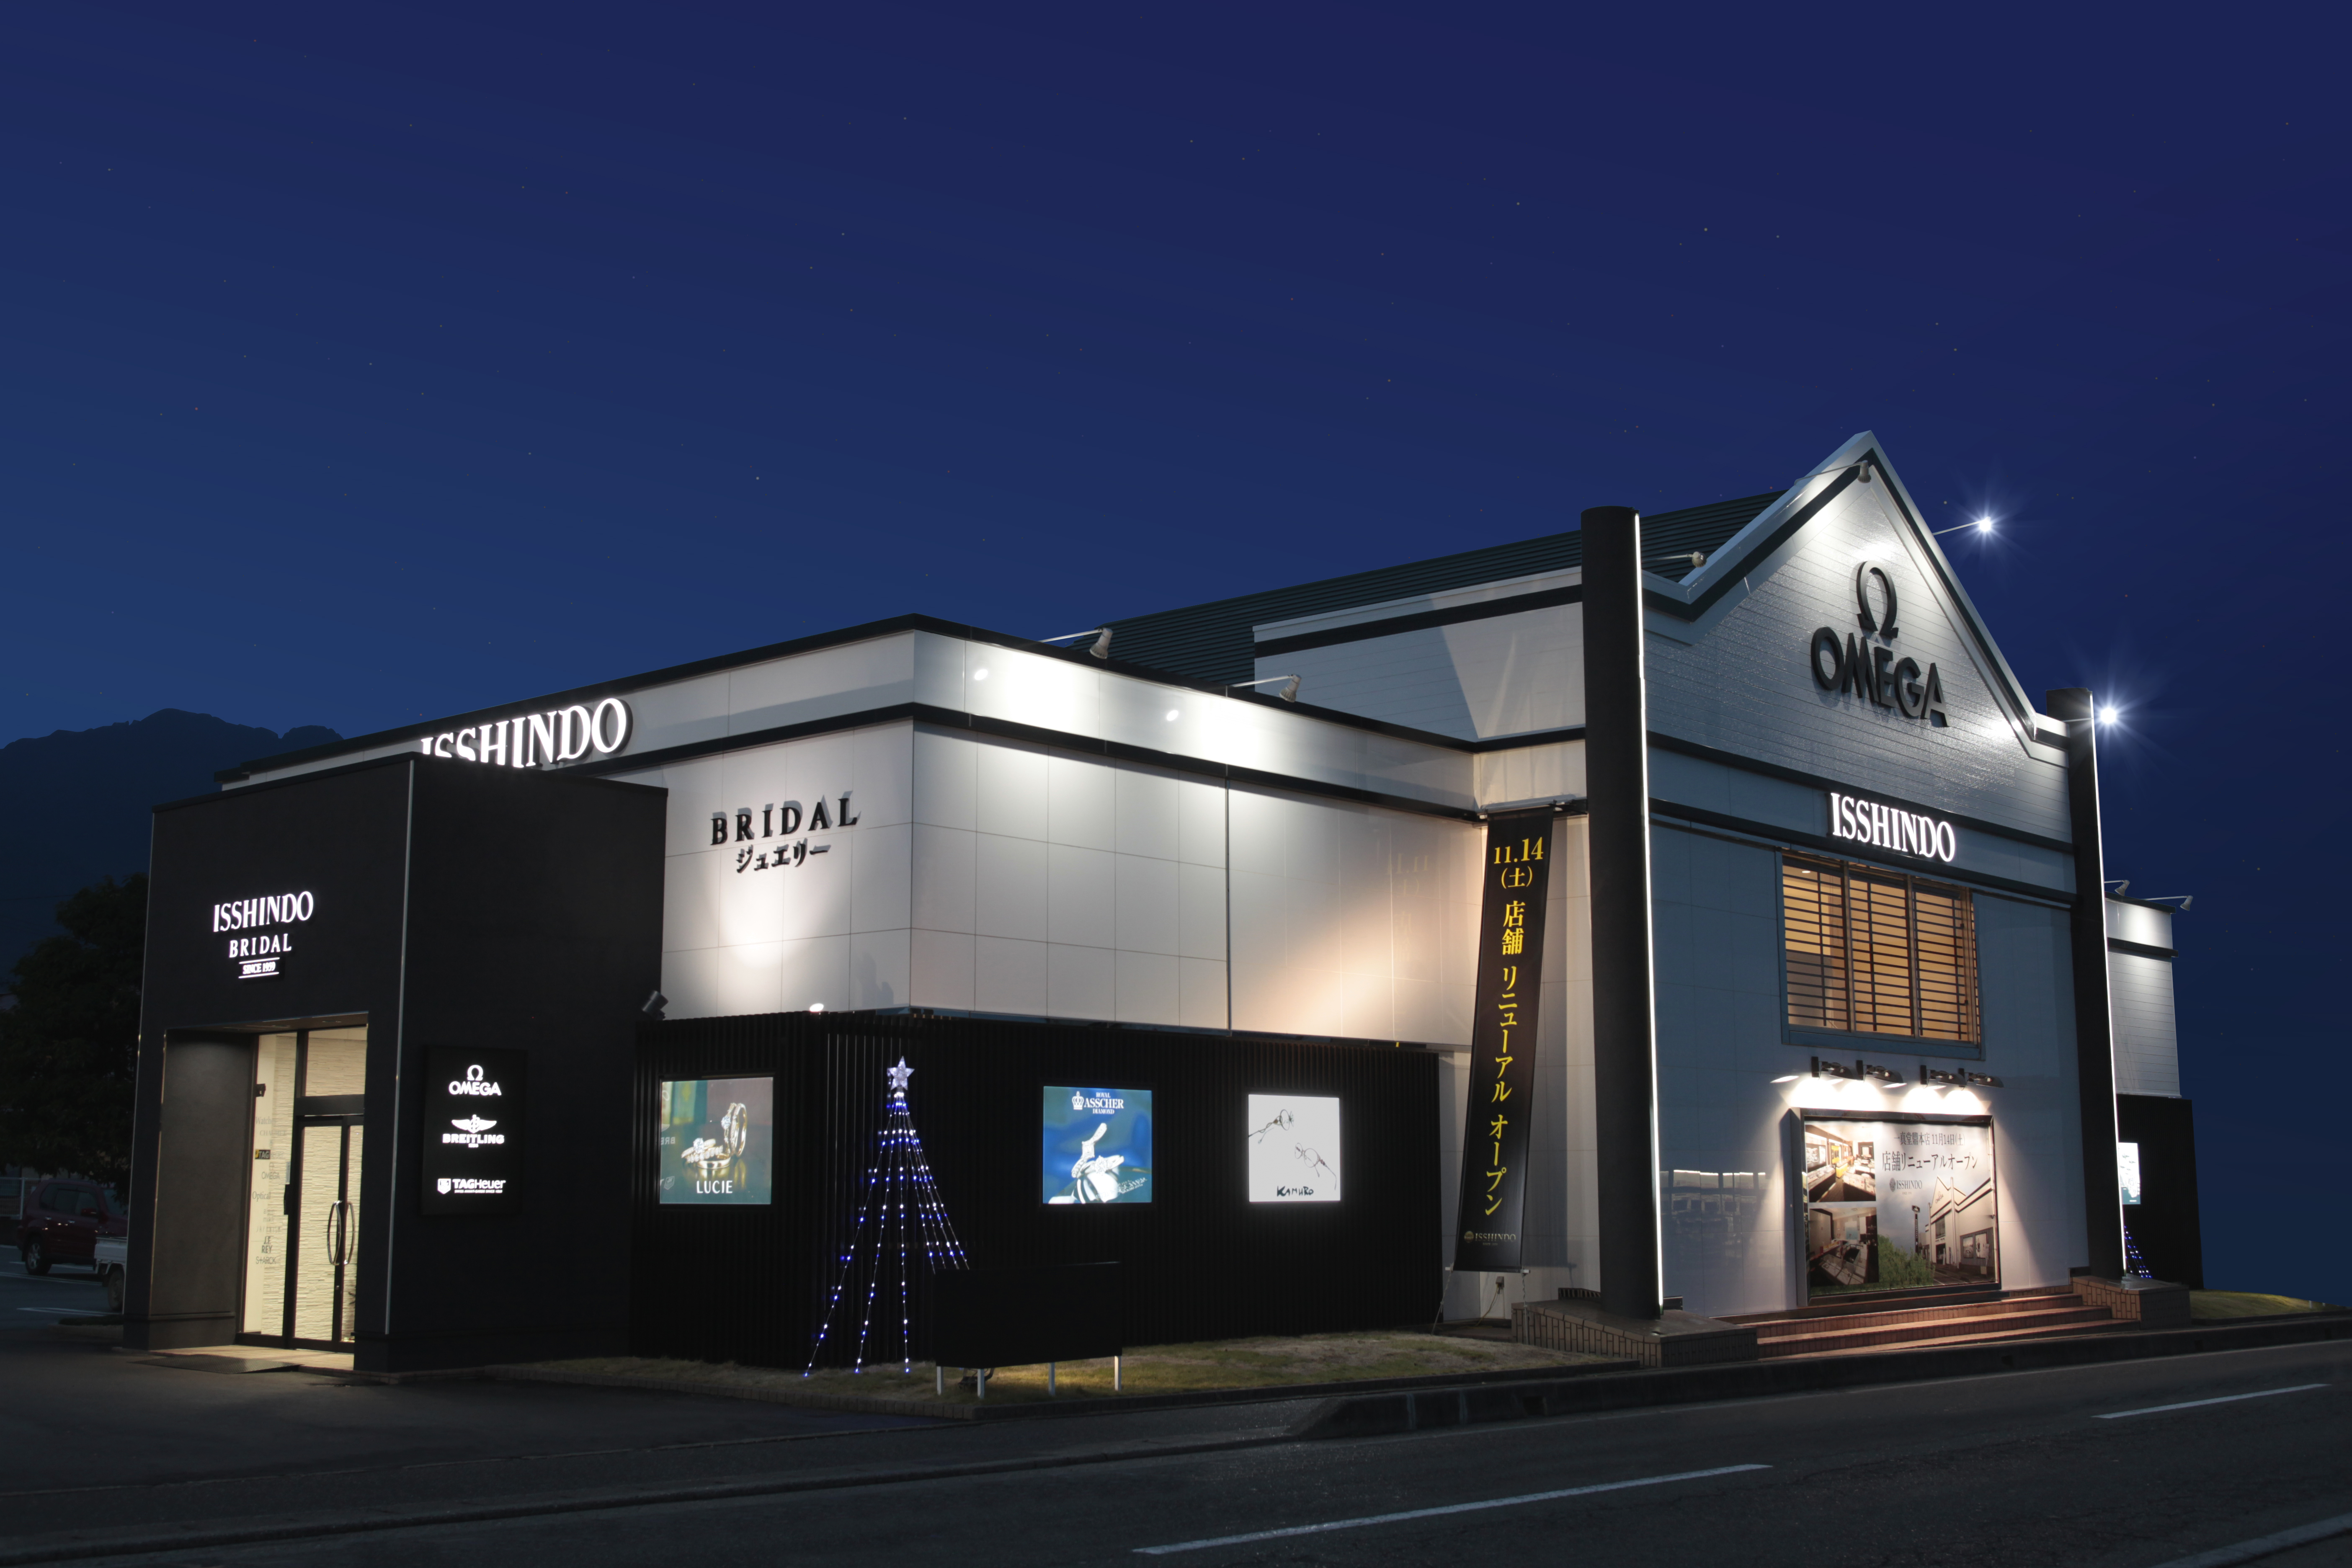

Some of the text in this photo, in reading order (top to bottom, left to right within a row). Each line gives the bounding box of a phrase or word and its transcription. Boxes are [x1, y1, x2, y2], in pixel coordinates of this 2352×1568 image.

[1810, 627, 1951, 727] OMEGA
[710, 797, 858, 846] BRIDAL
[1831, 793, 1955, 862] ISSHINDO
[1493, 837, 1544, 864] 11.14
[735, 843, 829, 874] ジュエリー
[213, 890, 314, 932] ISSHINDO
[229, 933, 292, 958] BRIDAL
[242, 961, 276, 974] SINCE 1959
[449, 1081, 502, 1096] OMEGA
[1084, 1098, 1124, 1109] ASSCHER
[442, 1133, 505, 1144] BREITLING
[1882, 1151, 1978, 1171] 店舗リニューアルオープン
[696, 1180, 732, 1194] LUCIE
[1896, 1180, 1922, 1189] ISSHINDO
[252, 1191, 271, 1202] Optical
[1475, 1233, 1516, 1242] ISSHINDO
[262, 1245, 272, 1253] REY
